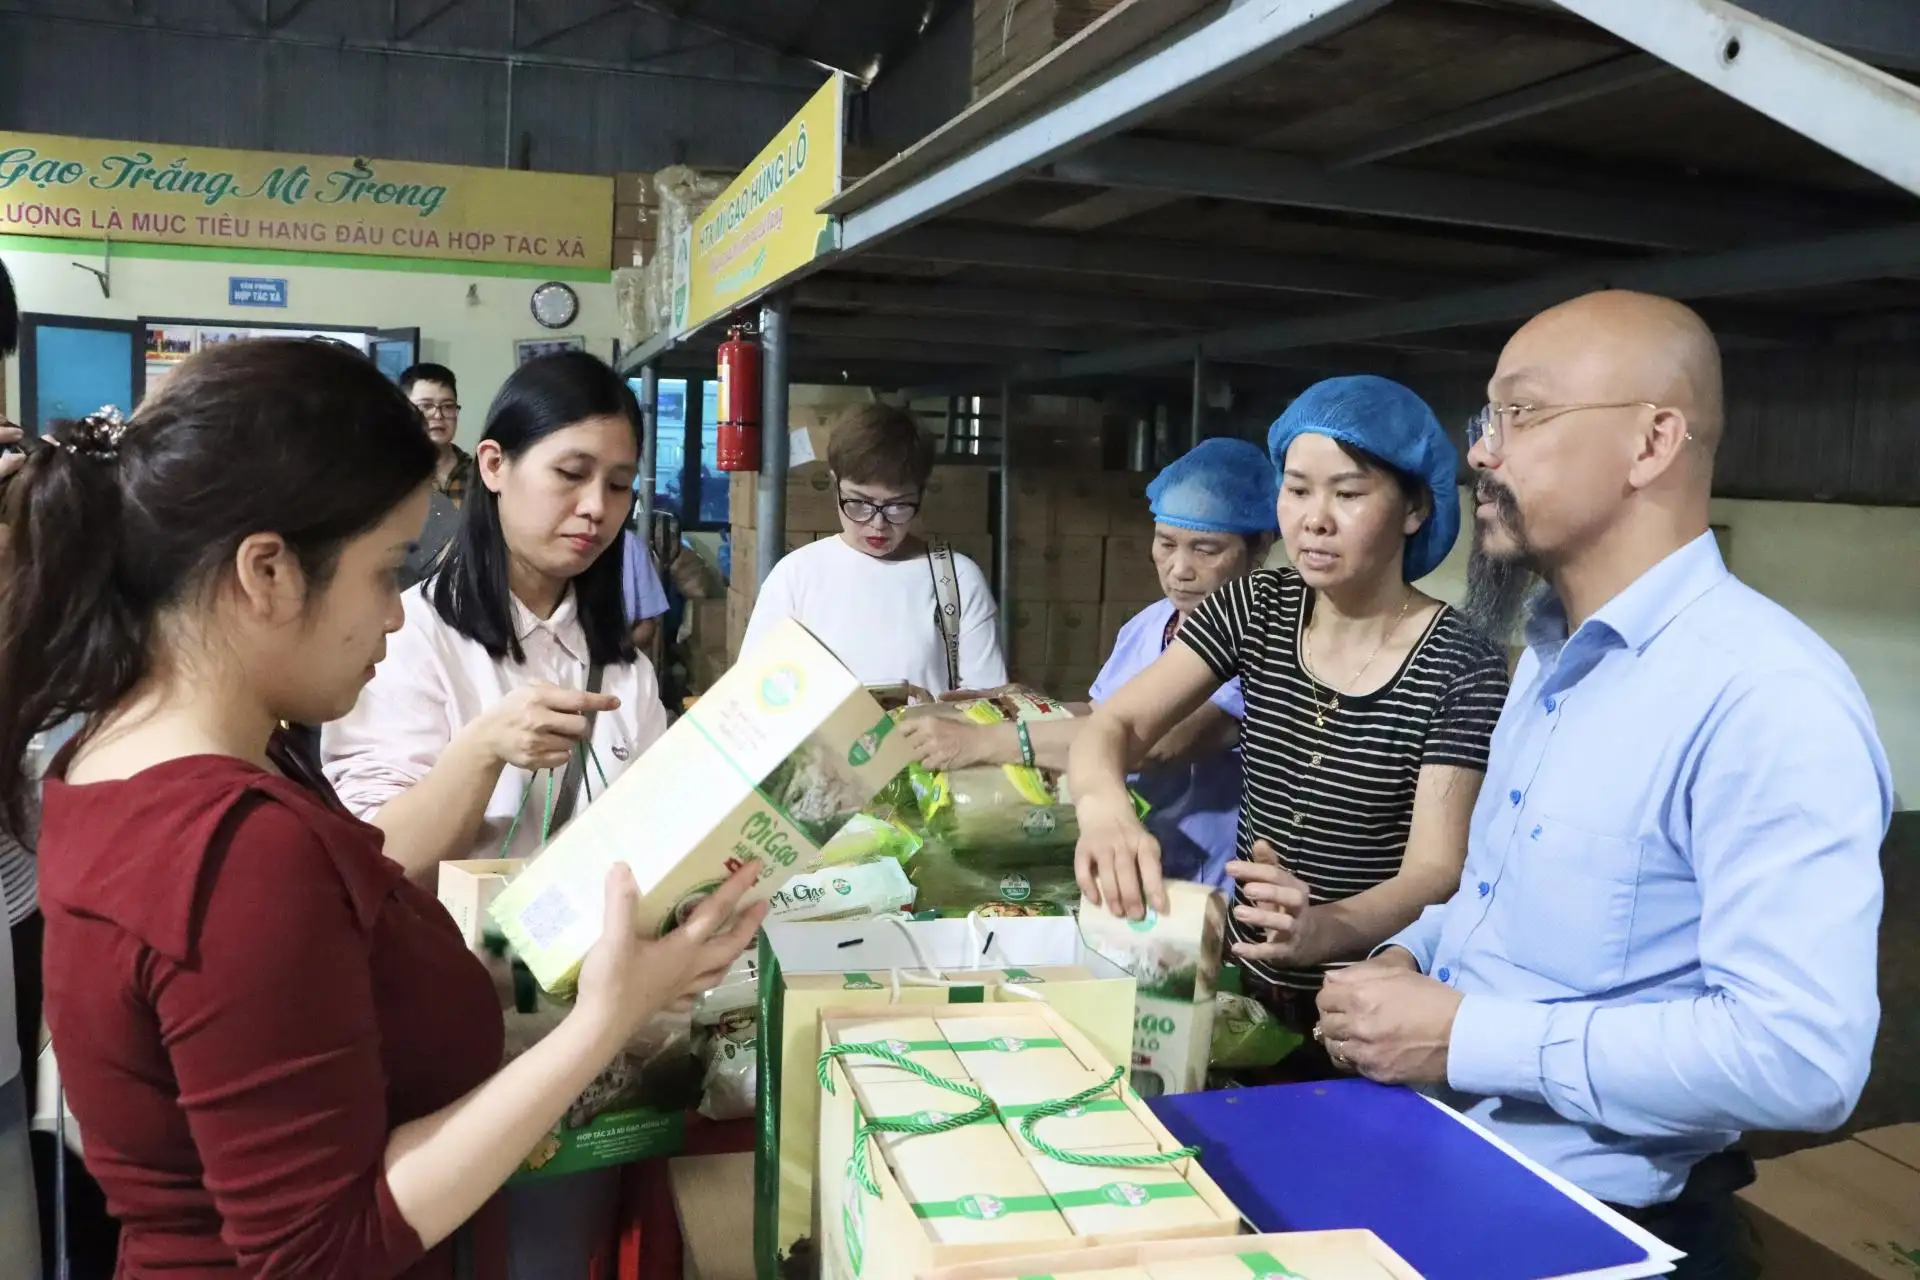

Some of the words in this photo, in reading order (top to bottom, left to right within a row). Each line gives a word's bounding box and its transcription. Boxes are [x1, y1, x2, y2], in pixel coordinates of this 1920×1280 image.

[88, 151, 236, 206] Trắng
[236, 165, 312, 205] Mì
[314, 163, 447, 217] Trong
[750, 154, 785, 212] HÙNG
[788, 121, 808, 178] LÔ
[0, 202, 82, 229] ƯỢNG
[91, 206, 123, 230] LÀ
[131, 212, 187, 237] MỤC
[194, 212, 251, 238] TIÊU
[447, 230, 496, 255] HỢP
[1134, 1013, 1176, 1035] ạo
